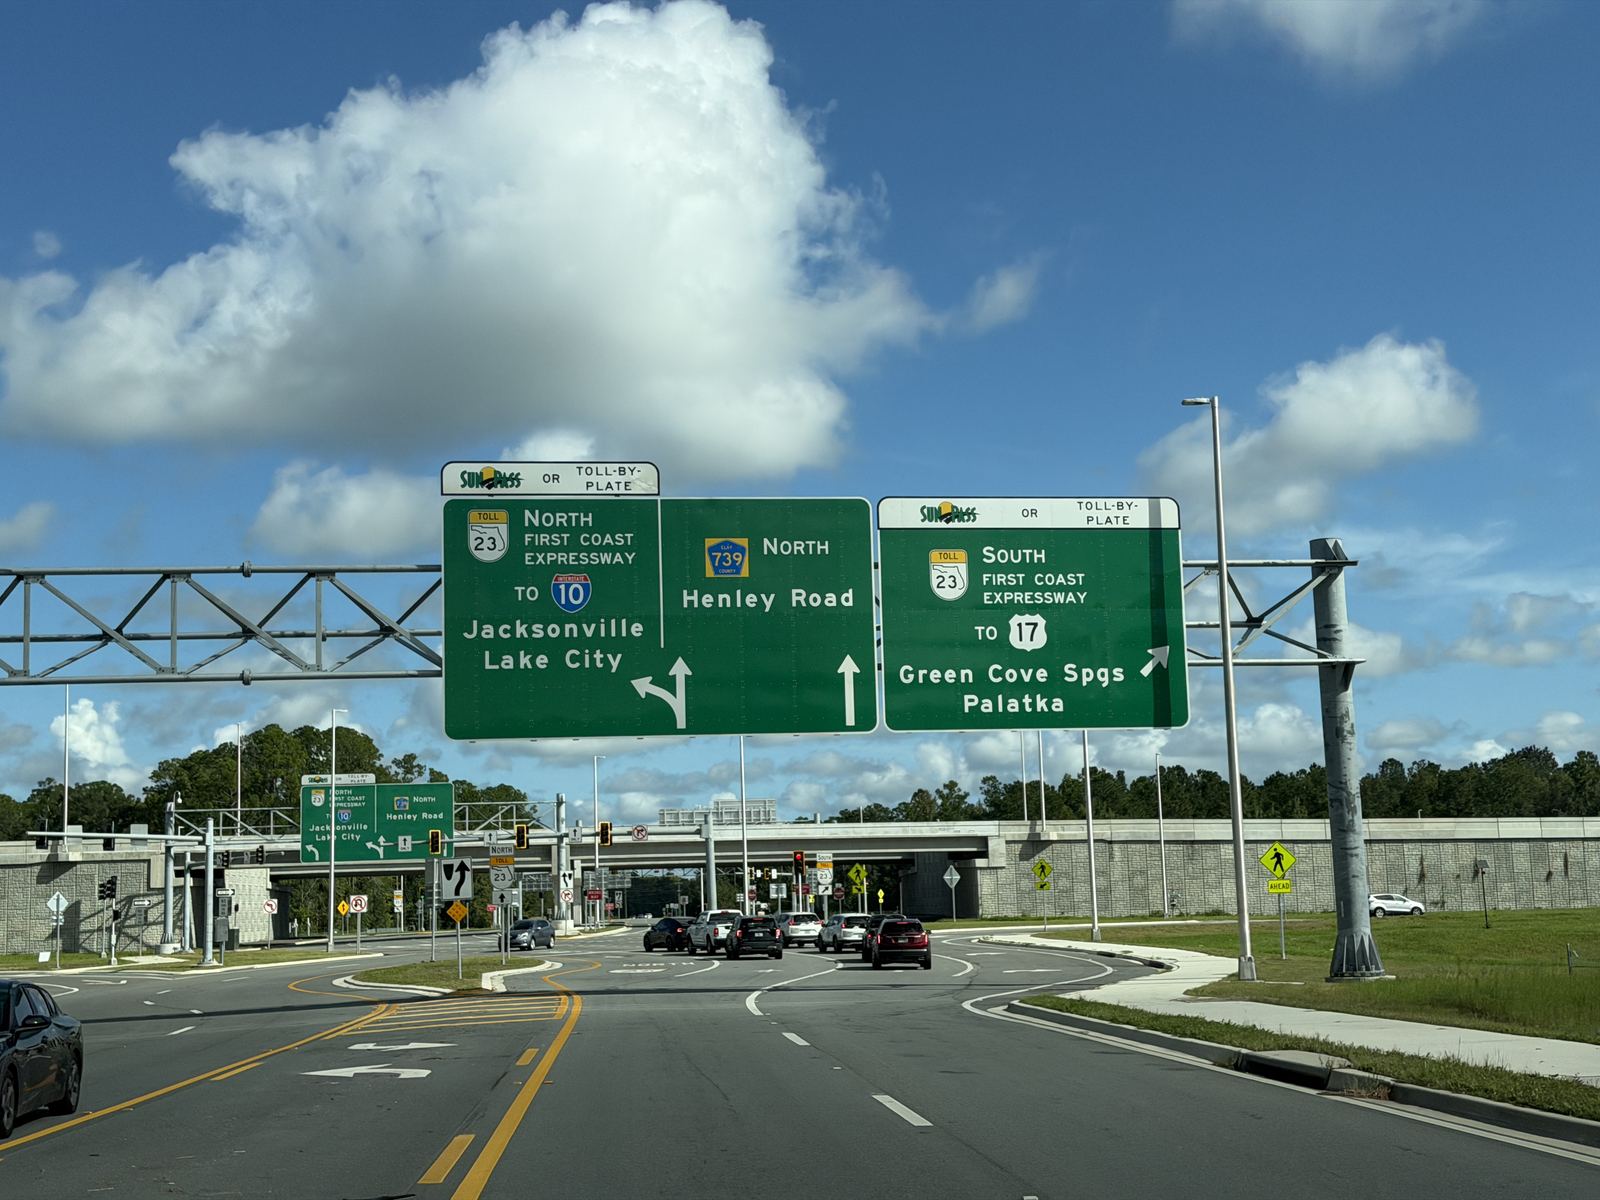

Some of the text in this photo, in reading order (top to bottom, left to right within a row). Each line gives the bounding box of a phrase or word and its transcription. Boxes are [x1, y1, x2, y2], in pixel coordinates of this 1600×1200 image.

[576, 467, 641, 477] TOLL-BY-
[543, 474, 559, 484] OR
[586, 482, 632, 491] PLATE
[1077, 502, 1138, 511] TOLL-BY-
[524, 510, 592, 527] NORTH
[1021, 509, 1037, 518] OR
[1087, 516, 1130, 525] PLATE
[474, 537, 498, 551] 23
[525, 534, 633, 546] FIRST COAST
[763, 538, 829, 555] NORTH
[525, 553, 636, 565] EXPRESSWAY
[712, 552, 742, 566] 739
[982, 547, 1045, 563] SOUTH
[936, 576, 957, 589] 23
[983, 574, 1085, 585] FIRST COAST
[514, 587, 538, 600] TO
[559, 584, 584, 605] 10
[984, 592, 1087, 604] EXPRESSWAY
[683, 589, 853, 612] Henley Road
[463, 620, 643, 639] Jacksonville
[975, 627, 997, 640] TO
[1016, 622, 1038, 642] 17
[484, 651, 622, 672] Lake City
[899, 664, 1125, 687] Green Cove Spgs
[964, 695, 1064, 713] Palatka
[340, 812, 348, 820] 10
[387, 813, 417, 821] Henley
[342, 833, 360, 841] City
[492, 846, 512, 854] NORTH
